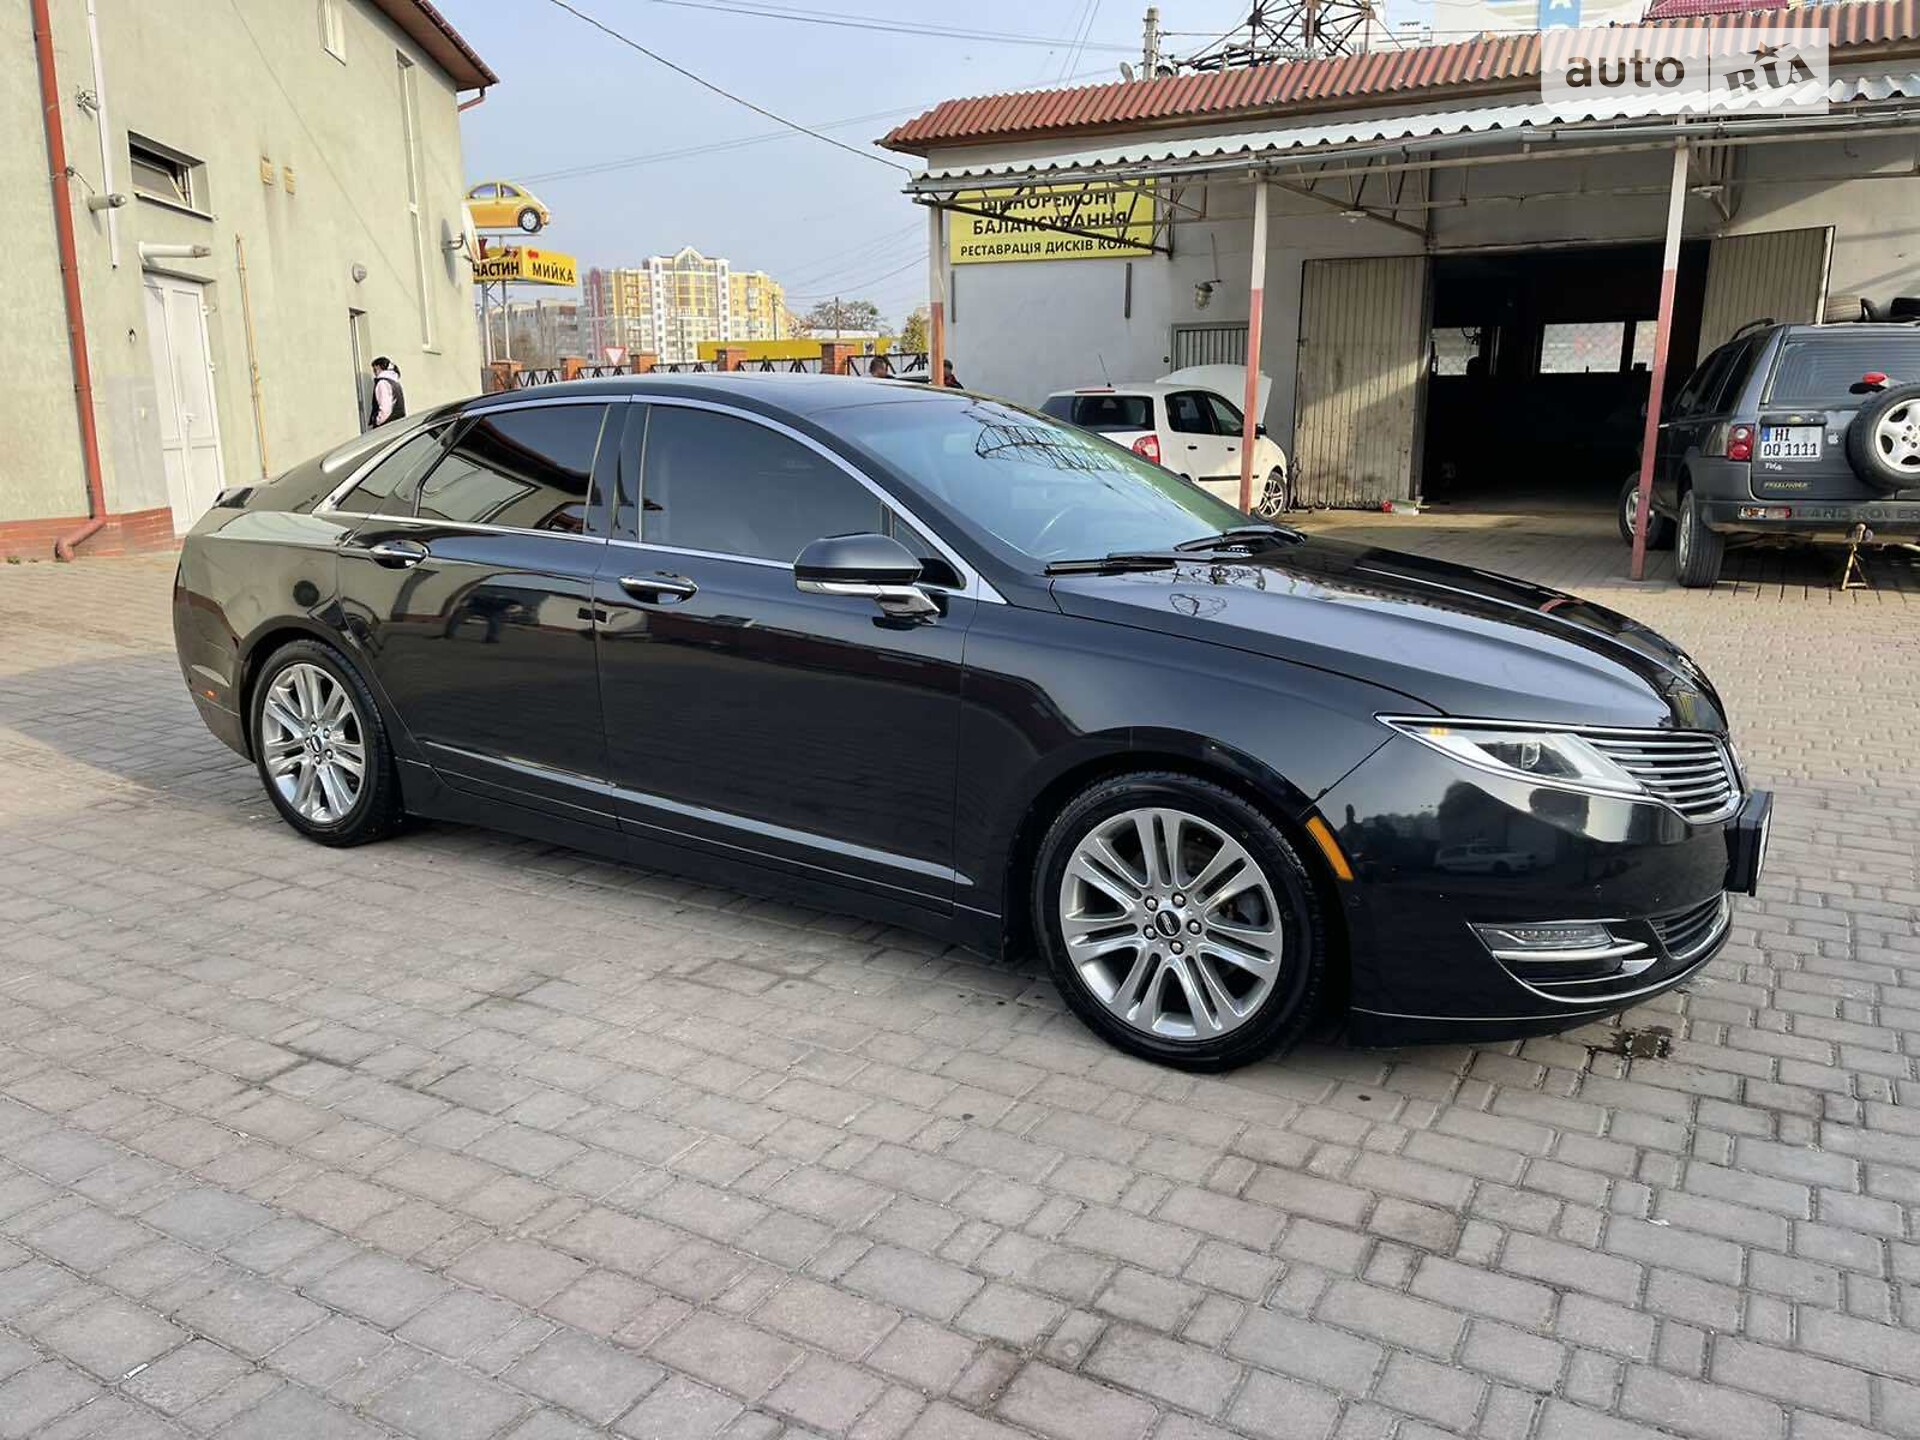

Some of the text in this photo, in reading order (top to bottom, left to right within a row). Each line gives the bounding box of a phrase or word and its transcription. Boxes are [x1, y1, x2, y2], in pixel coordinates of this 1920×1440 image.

[960, 242, 1041, 257] РЕСТАВРАЦІЯ
[1045, 240, 1093, 254] ДИСКІВ
[532, 262, 574, 283] МИЙКА
[1774, 428, 1790, 441] HI
[1784, 443, 1817, 456] 1111
